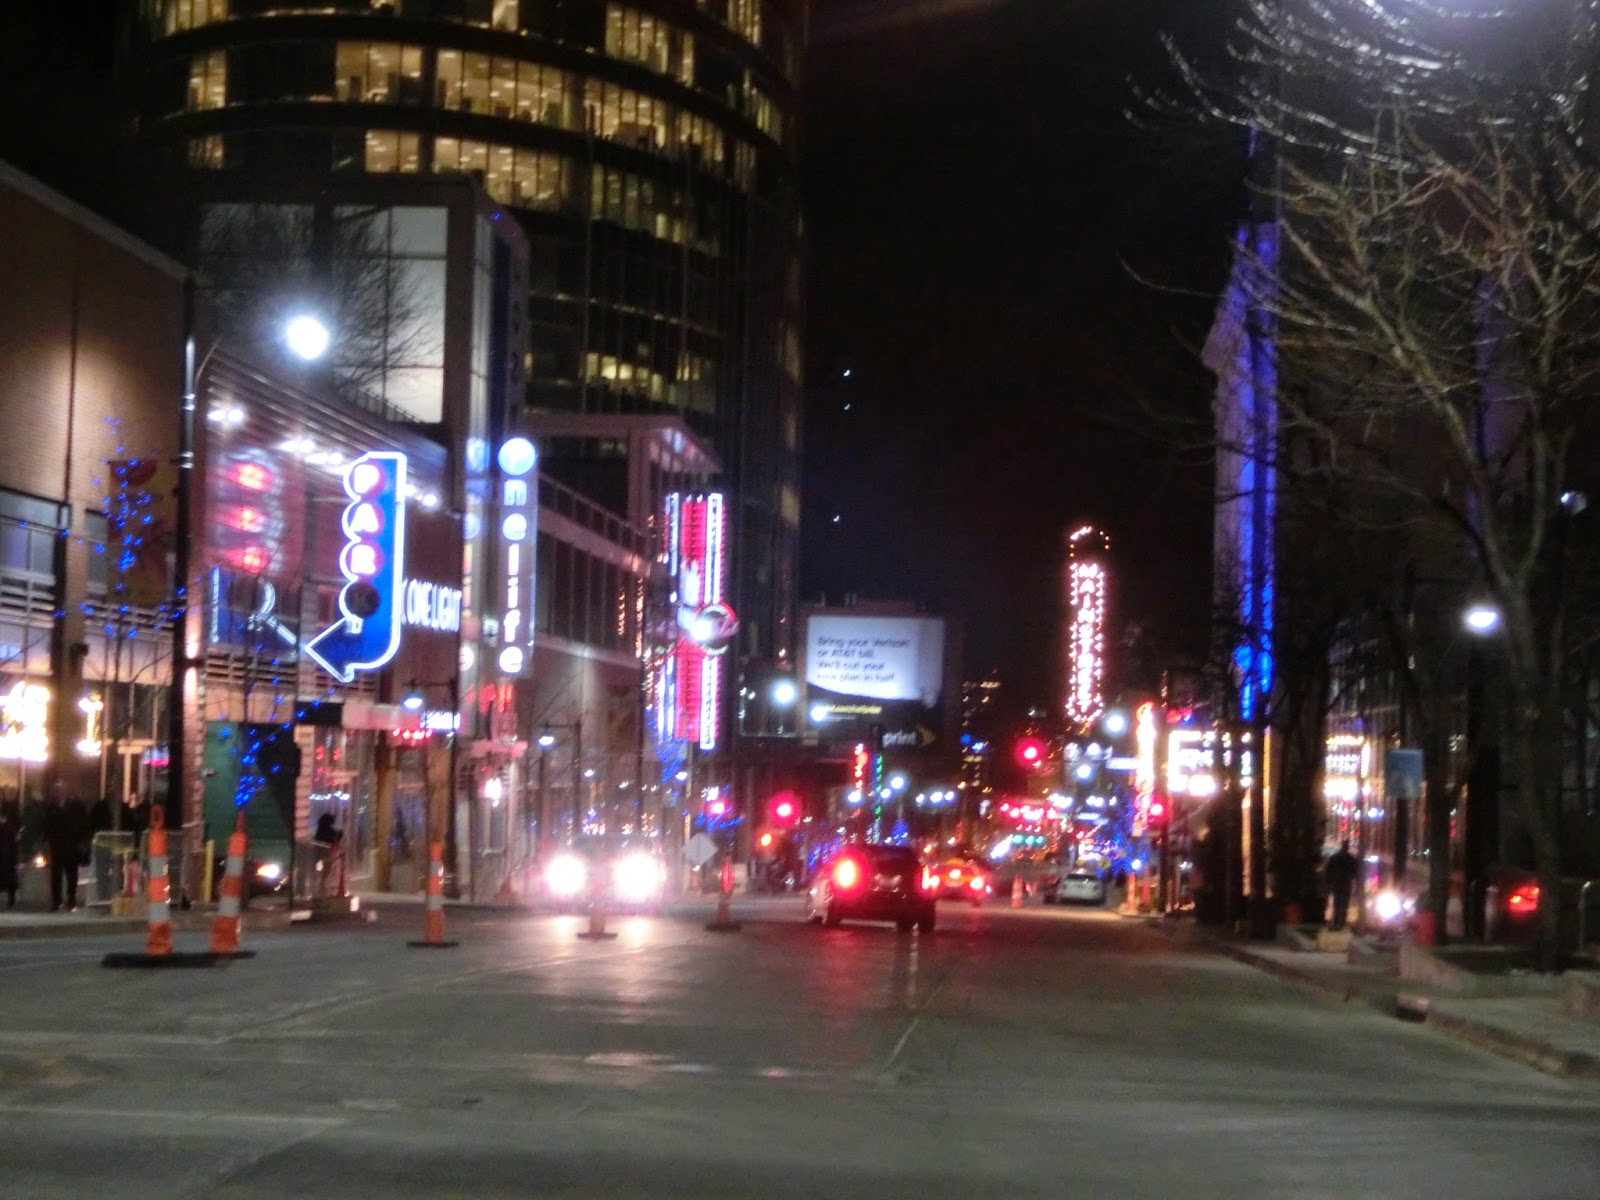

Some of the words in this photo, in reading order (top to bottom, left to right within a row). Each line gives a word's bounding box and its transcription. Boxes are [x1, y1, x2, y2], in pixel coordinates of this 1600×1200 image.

[350, 464, 380, 612] PAR
[407, 578, 432, 626] ONE
[432, 584, 462, 632] LIGHT
[817, 636, 844, 647] Bring
[848, 638, 869, 648] your
[817, 649, 828, 657] or
[864, 663, 885, 672] your
[882, 730, 917, 748] print
